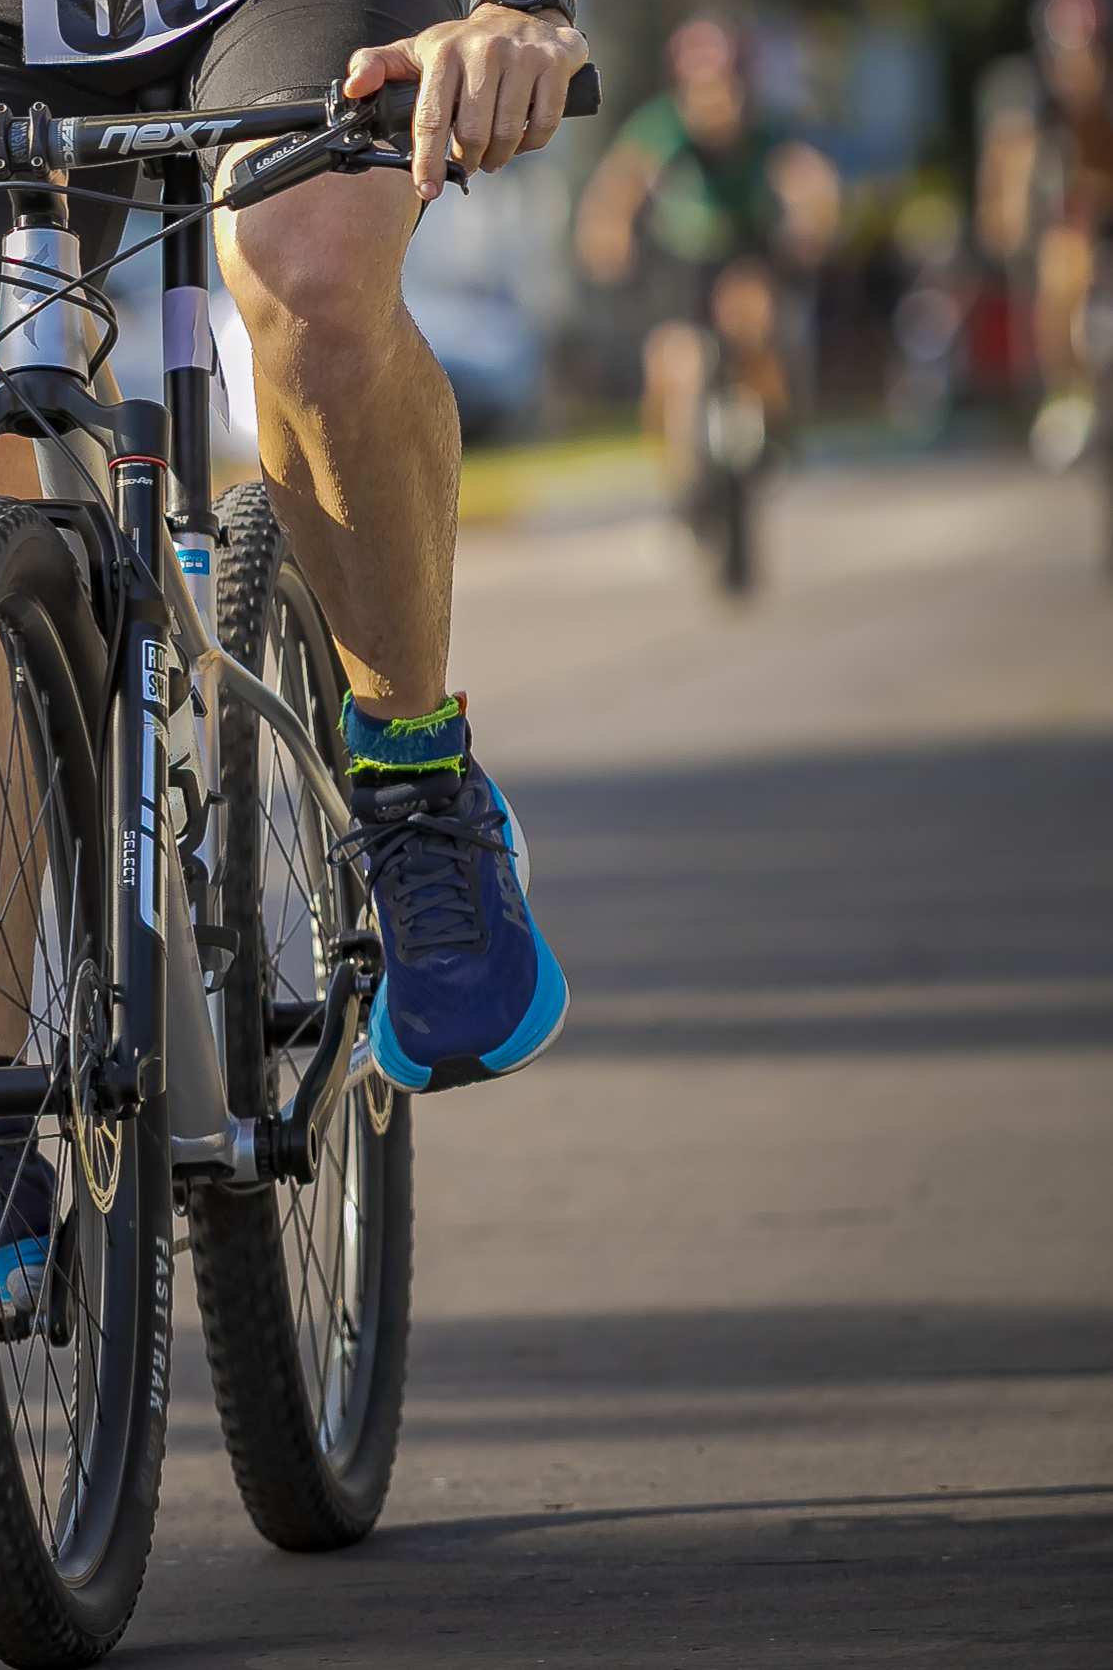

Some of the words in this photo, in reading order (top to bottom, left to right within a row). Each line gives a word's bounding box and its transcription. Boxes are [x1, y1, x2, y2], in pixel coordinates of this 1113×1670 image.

[123, 830, 136, 886] SELECT
[155, 1235, 170, 1322] FAST
[149, 1331, 167, 1417] TRAK
